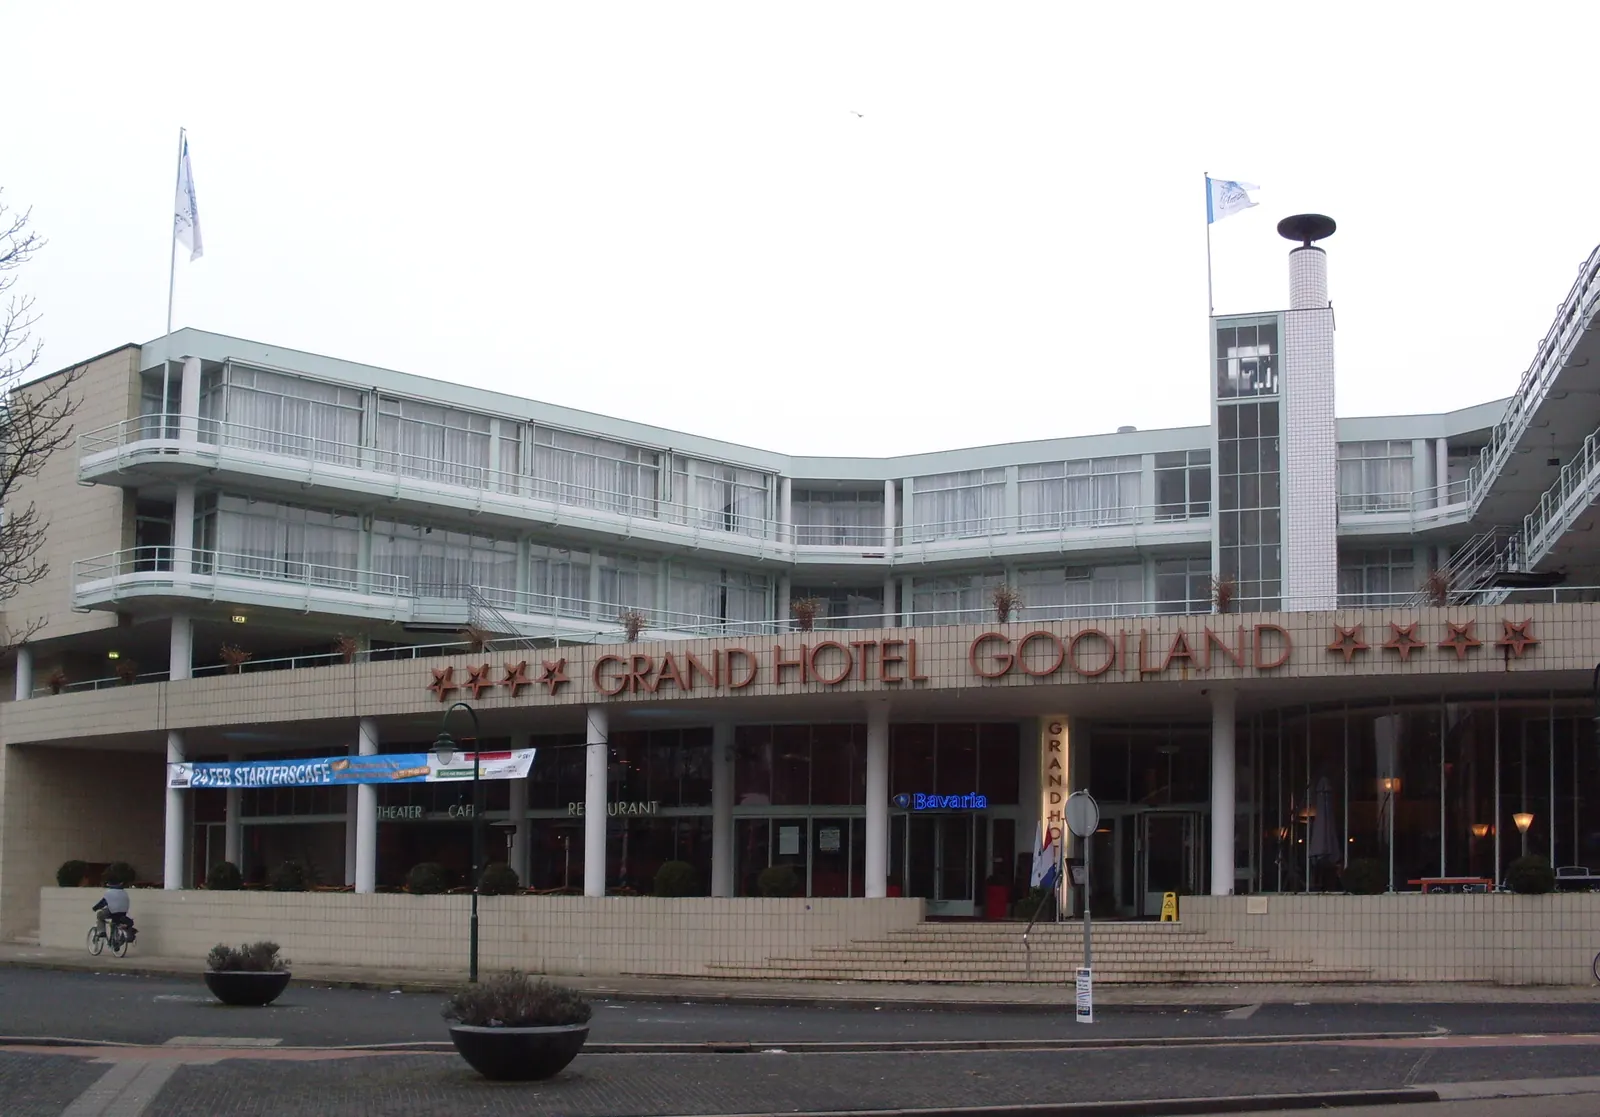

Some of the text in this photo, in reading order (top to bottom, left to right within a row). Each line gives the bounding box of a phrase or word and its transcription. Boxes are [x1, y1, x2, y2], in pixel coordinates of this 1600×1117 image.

[592, 623, 1293, 696] GRAND HOTEL GOOILAND
[192, 769, 208, 785] 24
[209, 768, 231, 785] FEB
[234, 759, 330, 786] STARTERSCAFÉ
[1048, 722, 1062, 805] GRAND
[377, 805, 422, 819] THEATER
[568, 801, 658, 816] REURANT
[913, 792, 987, 810] Bavaria
